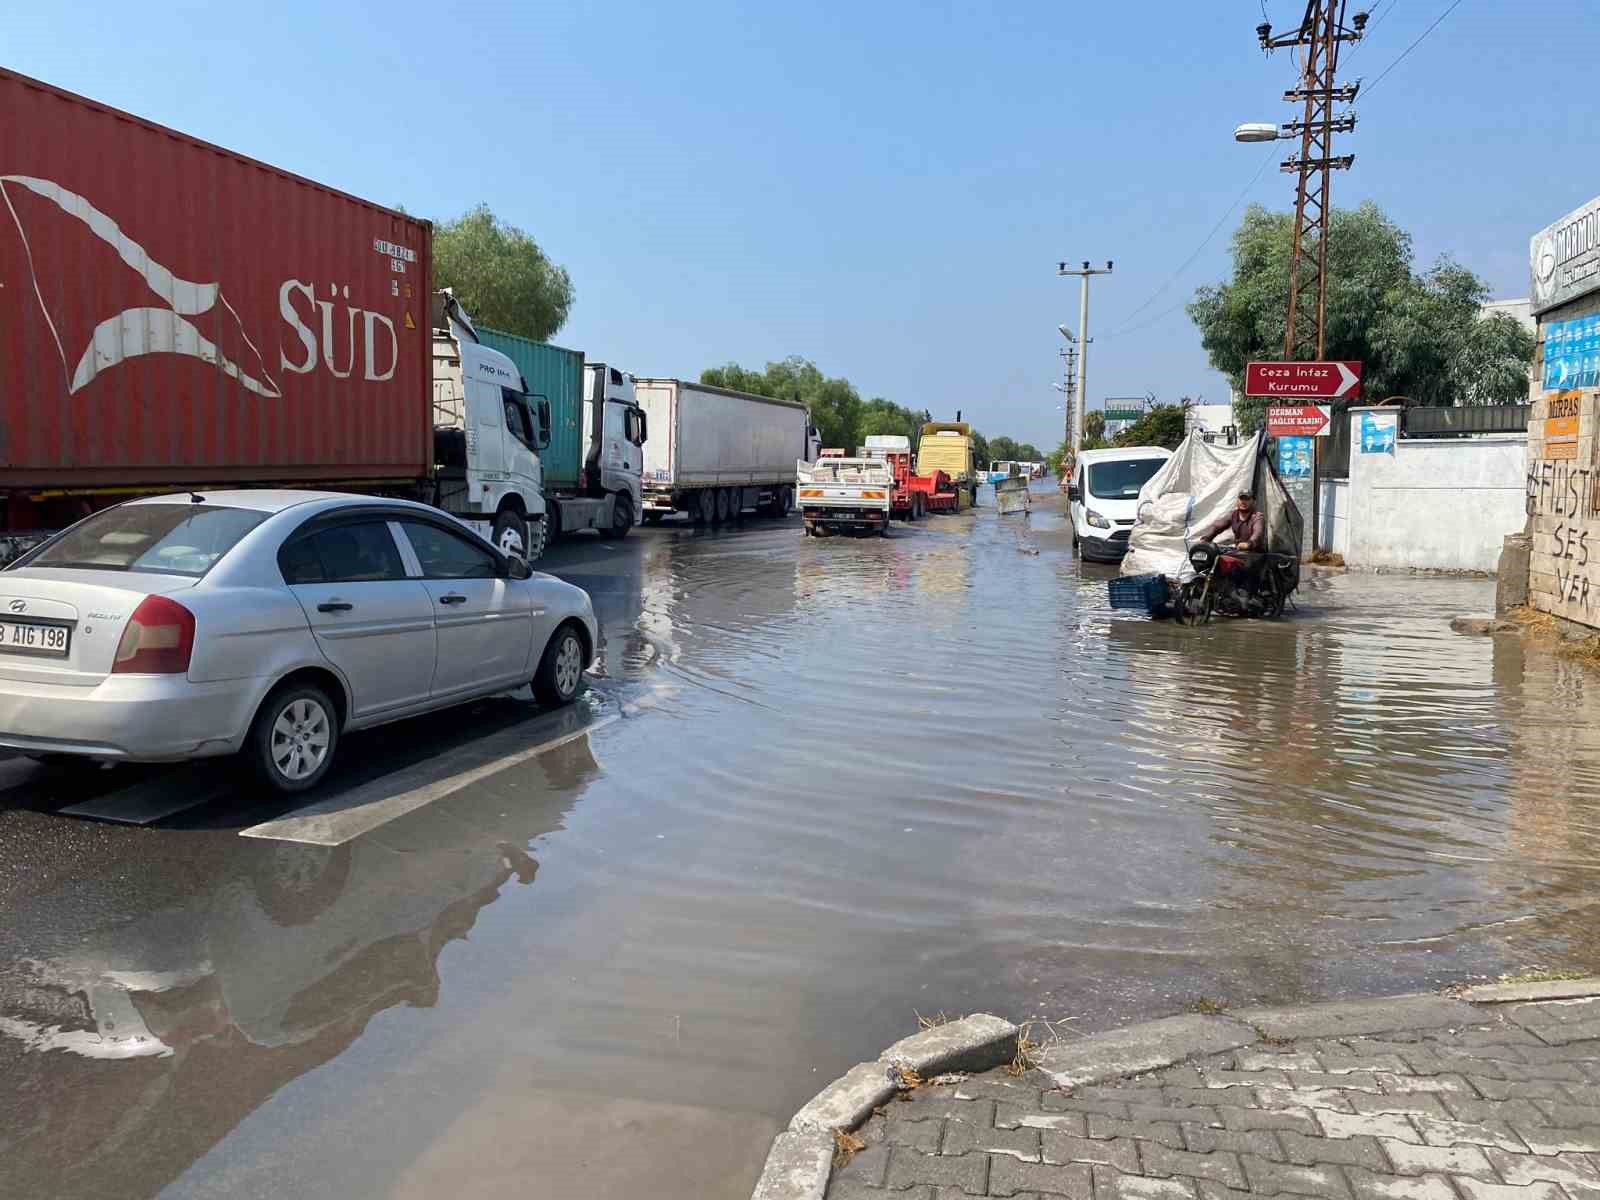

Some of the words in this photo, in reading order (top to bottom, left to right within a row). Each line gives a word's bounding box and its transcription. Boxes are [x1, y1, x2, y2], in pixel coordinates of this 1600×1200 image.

[279, 279, 398, 381] SÜD
[1260, 367, 1290, 377] Ceza
[1296, 366, 1329, 377] İnfaz
[1268, 382, 1319, 392] Kurumu
[1552, 521, 1588, 566] SES
[1557, 567, 1590, 616] VER
[13, 625, 35, 645] AIG
[41, 628, 65, 647] 198
